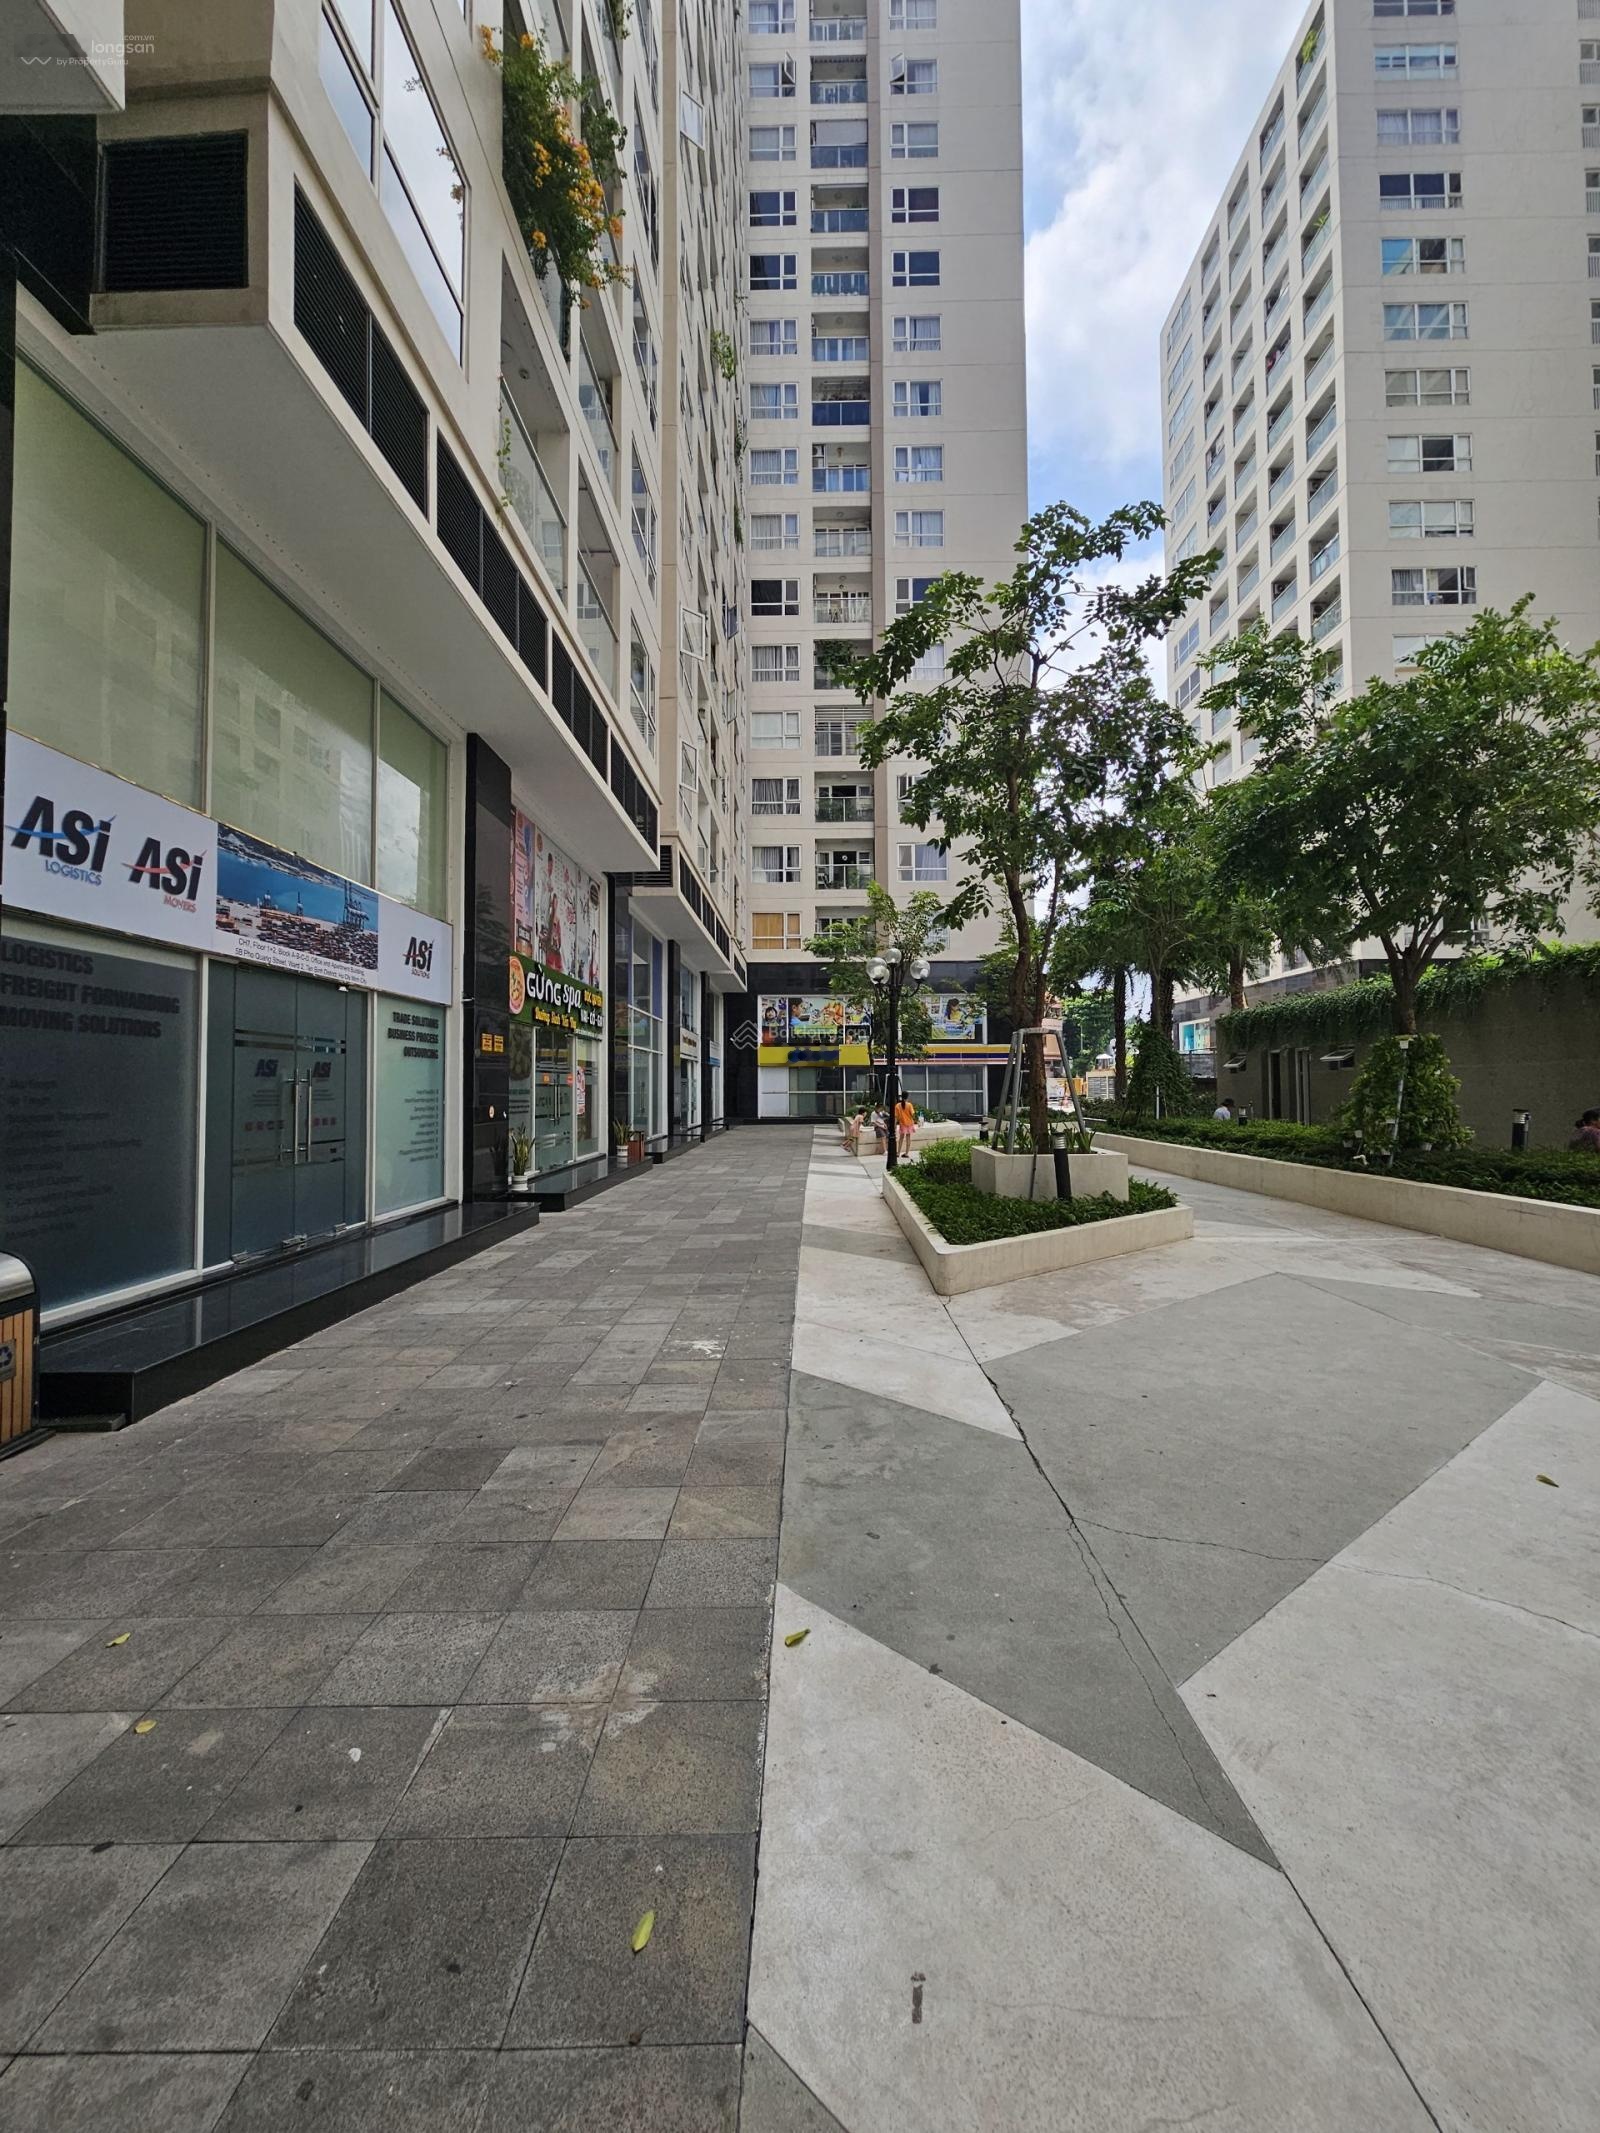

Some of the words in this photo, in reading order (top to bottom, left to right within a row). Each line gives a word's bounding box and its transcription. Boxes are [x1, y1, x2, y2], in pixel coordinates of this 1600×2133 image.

[45, 859, 103, 886] LOGISTICS
[163, 895, 197, 914] MOVERS
[253, 941, 265, 951] Floor
[0, 941, 94, 975] LOGISTICS
[0, 972, 78, 1002] FREIGHT
[80, 984, 181, 1014] FORWARDING
[0, 1005, 74, 1032] MOVING
[77, 1014, 162, 1038] SOLUTIONS
[392, 1011, 411, 1025] TRADE
[411, 1014, 439, 1029] SOLUTIONS
[388, 1027, 415, 1041] BUSINESS
[415, 1031, 439, 1044] PROCESS
[403, 1046, 439, 1059] OUTSOURCING
